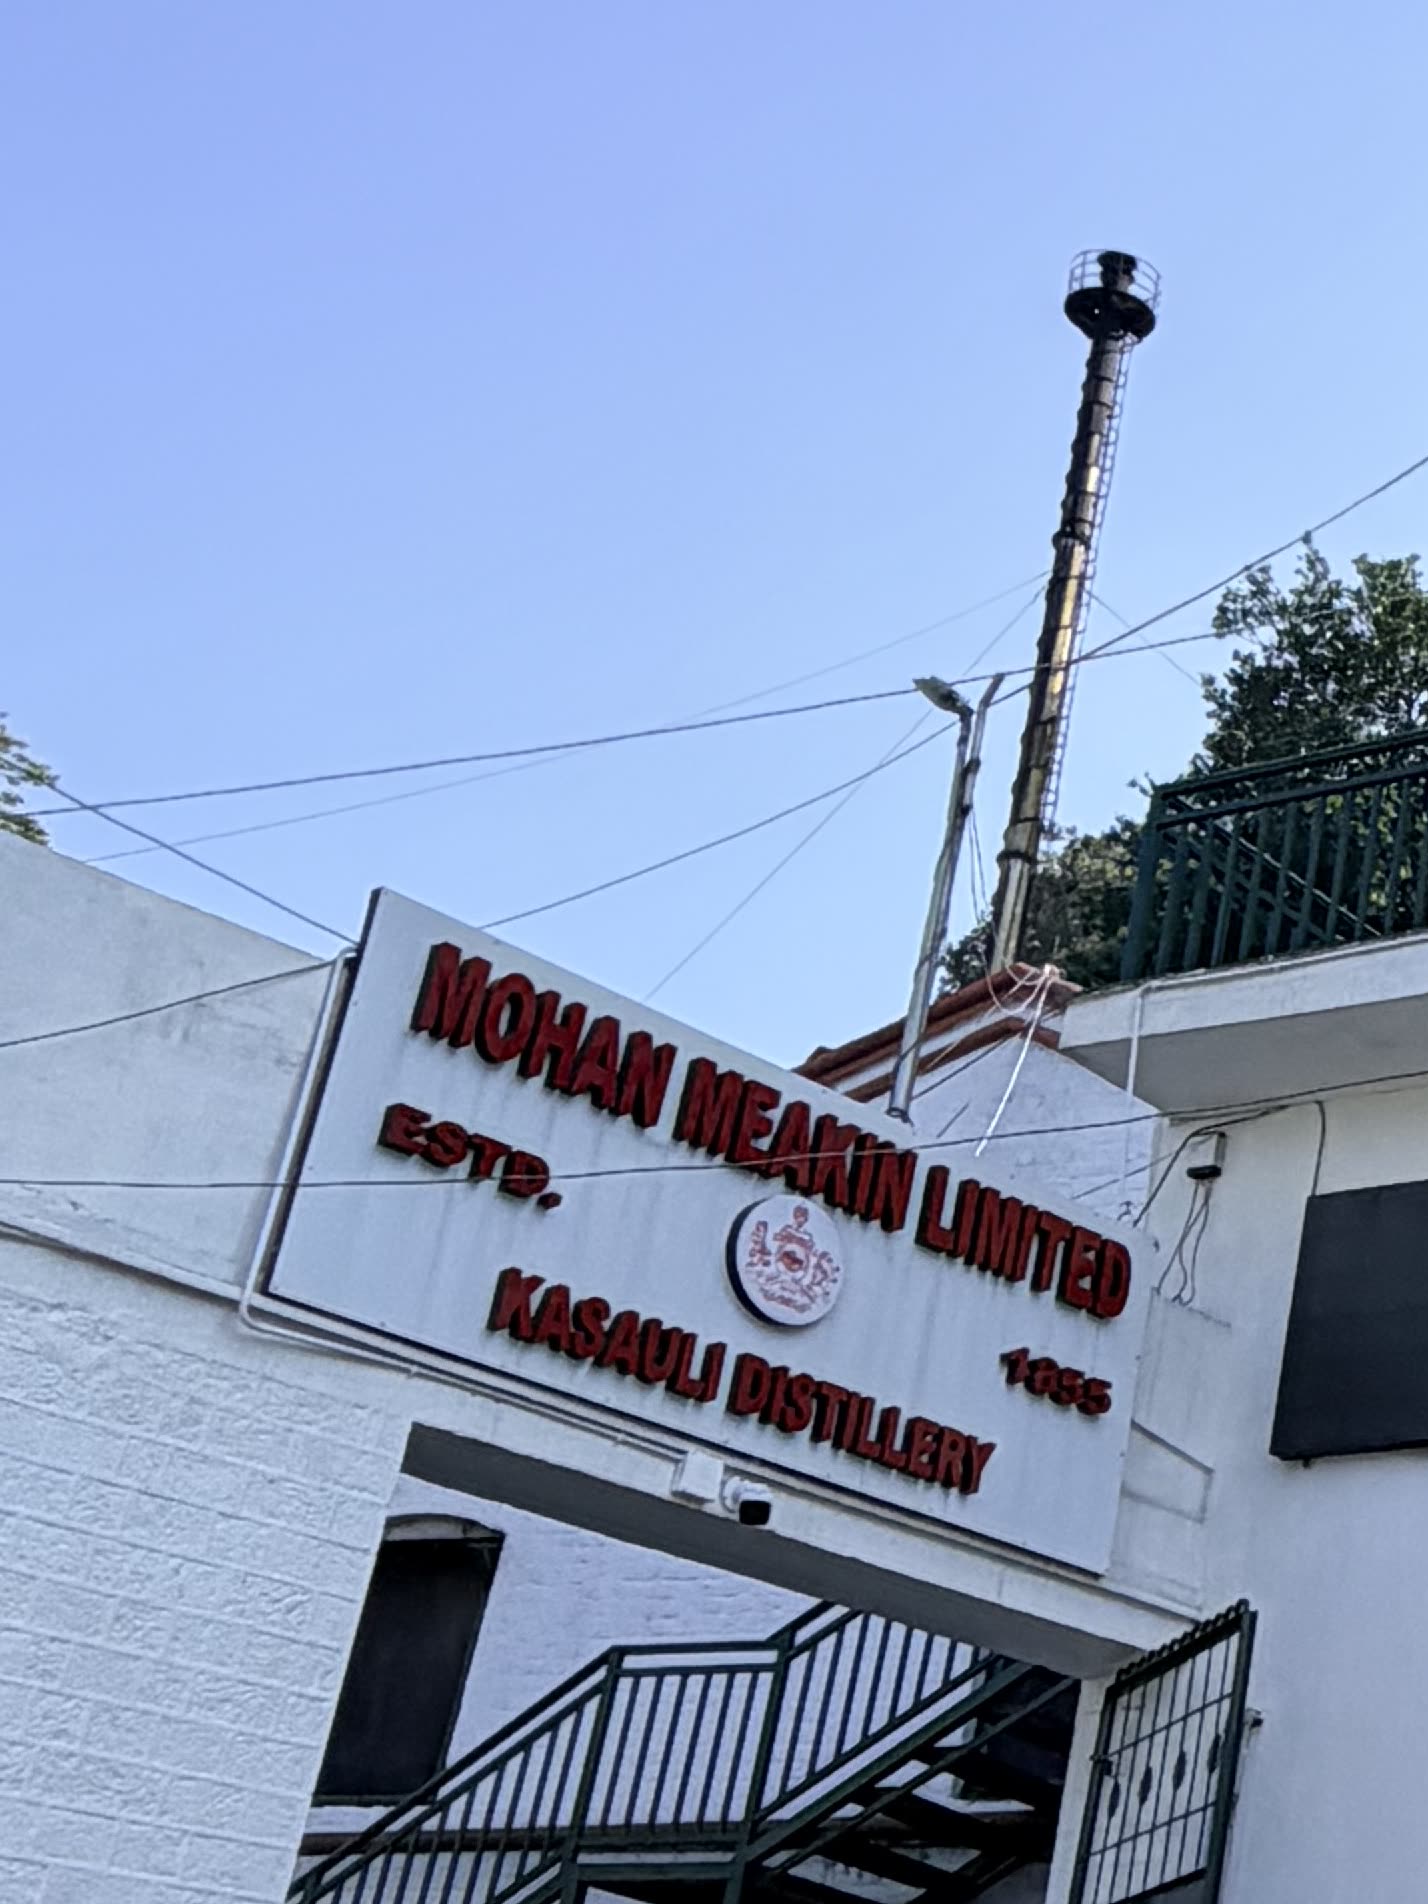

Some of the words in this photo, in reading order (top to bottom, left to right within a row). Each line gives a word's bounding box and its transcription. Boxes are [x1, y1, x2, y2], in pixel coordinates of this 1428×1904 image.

[376, 1102, 562, 1210] ESTD.
[410, 941, 677, 1129] MOHAN
[672, 1056, 917, 1234] MEAKIN
[914, 1165, 1132, 1321] LIMITED
[486, 1267, 726, 1404] KASAULI
[724, 1353, 996, 1496] DISTILLERY
[1000, 1346, 1114, 1420] 1855
